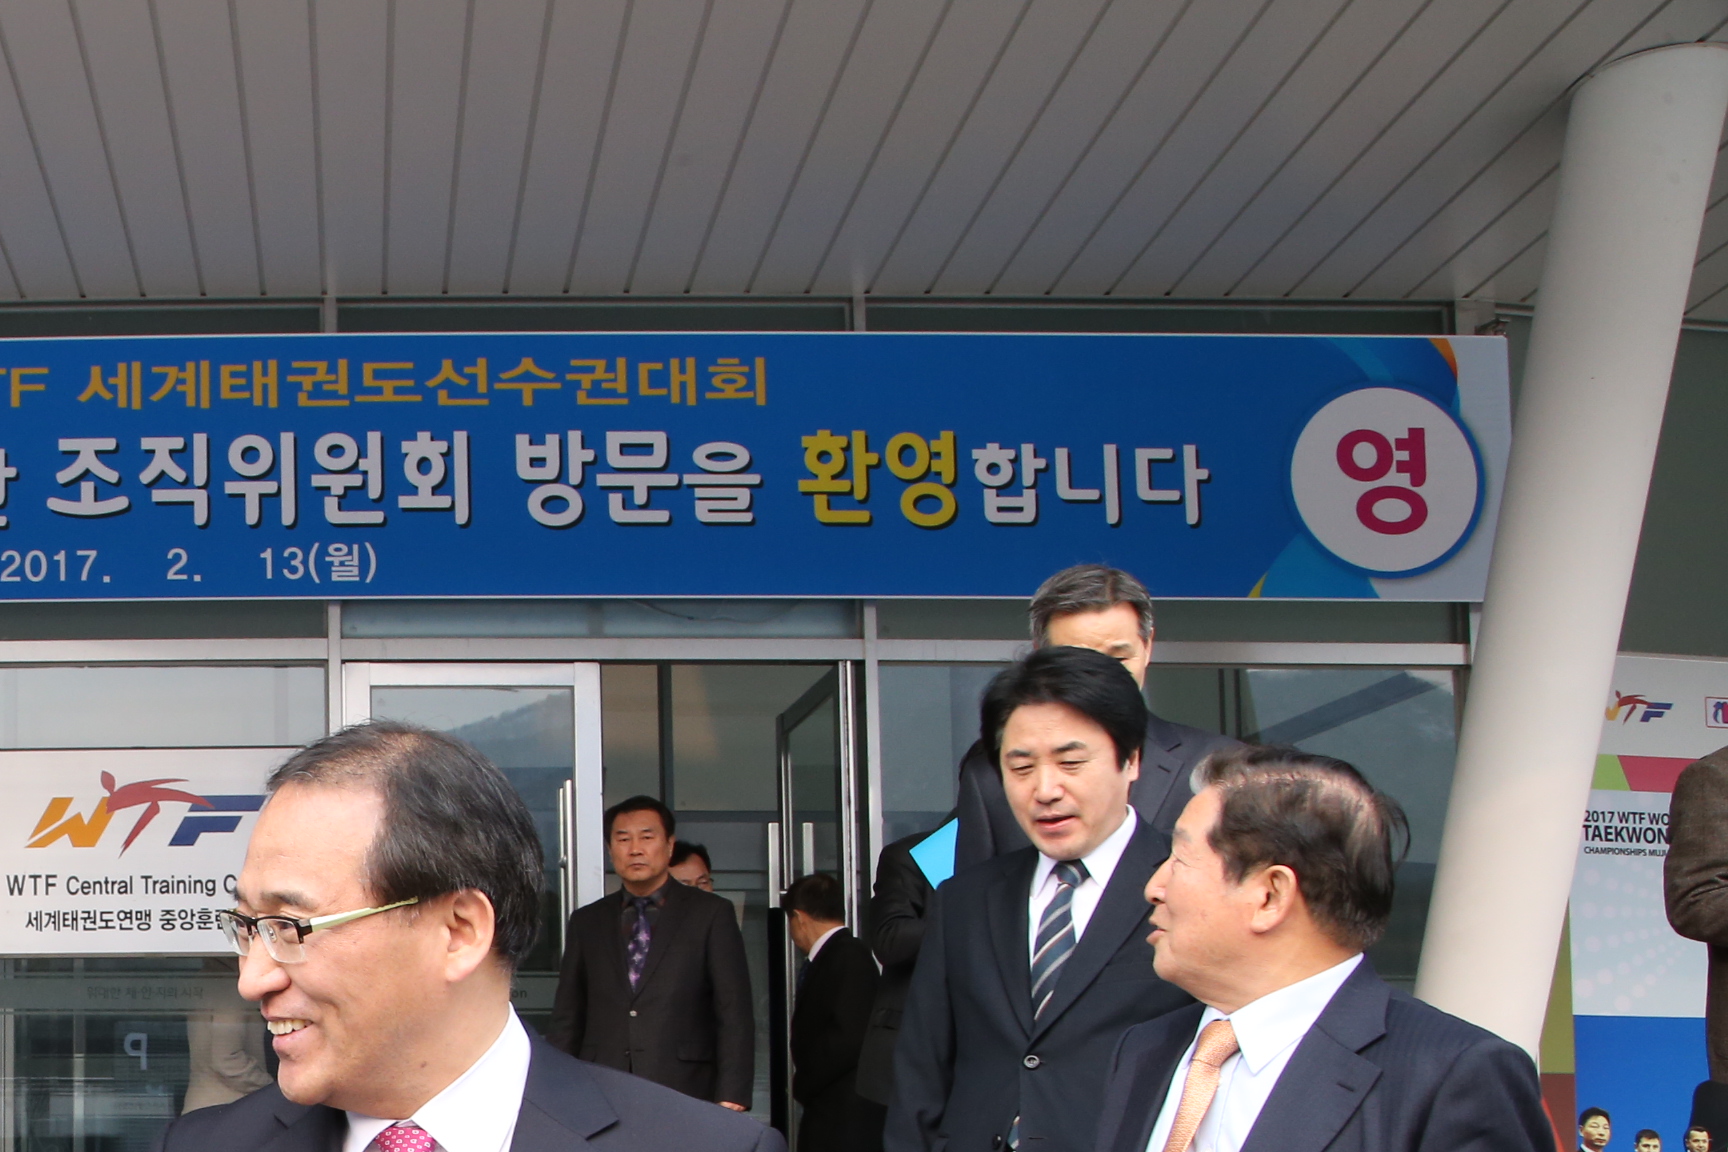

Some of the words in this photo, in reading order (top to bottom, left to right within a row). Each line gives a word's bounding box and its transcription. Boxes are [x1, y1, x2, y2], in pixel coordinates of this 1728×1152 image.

[77, 357, 768, 411] 세계태권도선수권대회
[46, 430, 472, 528] 조직위원회
[515, 430, 763, 527] 방문을
[797, 429, 1210, 528] 환영합니다
[1334, 427, 1428, 536] 영
[0, 550, 111, 582] 2017.
[166, 548, 202, 582] 2.
[259, 541, 377, 583] 13(월)
[1584, 810, 1615, 823] 2017
[1617, 811, 1646, 825] WTF
[1584, 846, 1647, 857] CHAMPIONSHIPS
[6, 874, 58, 896] WTF
[66, 875, 134, 896] Central
[140, 874, 217, 897] Training
[25, 908, 152, 932] 세계태권도연맹
